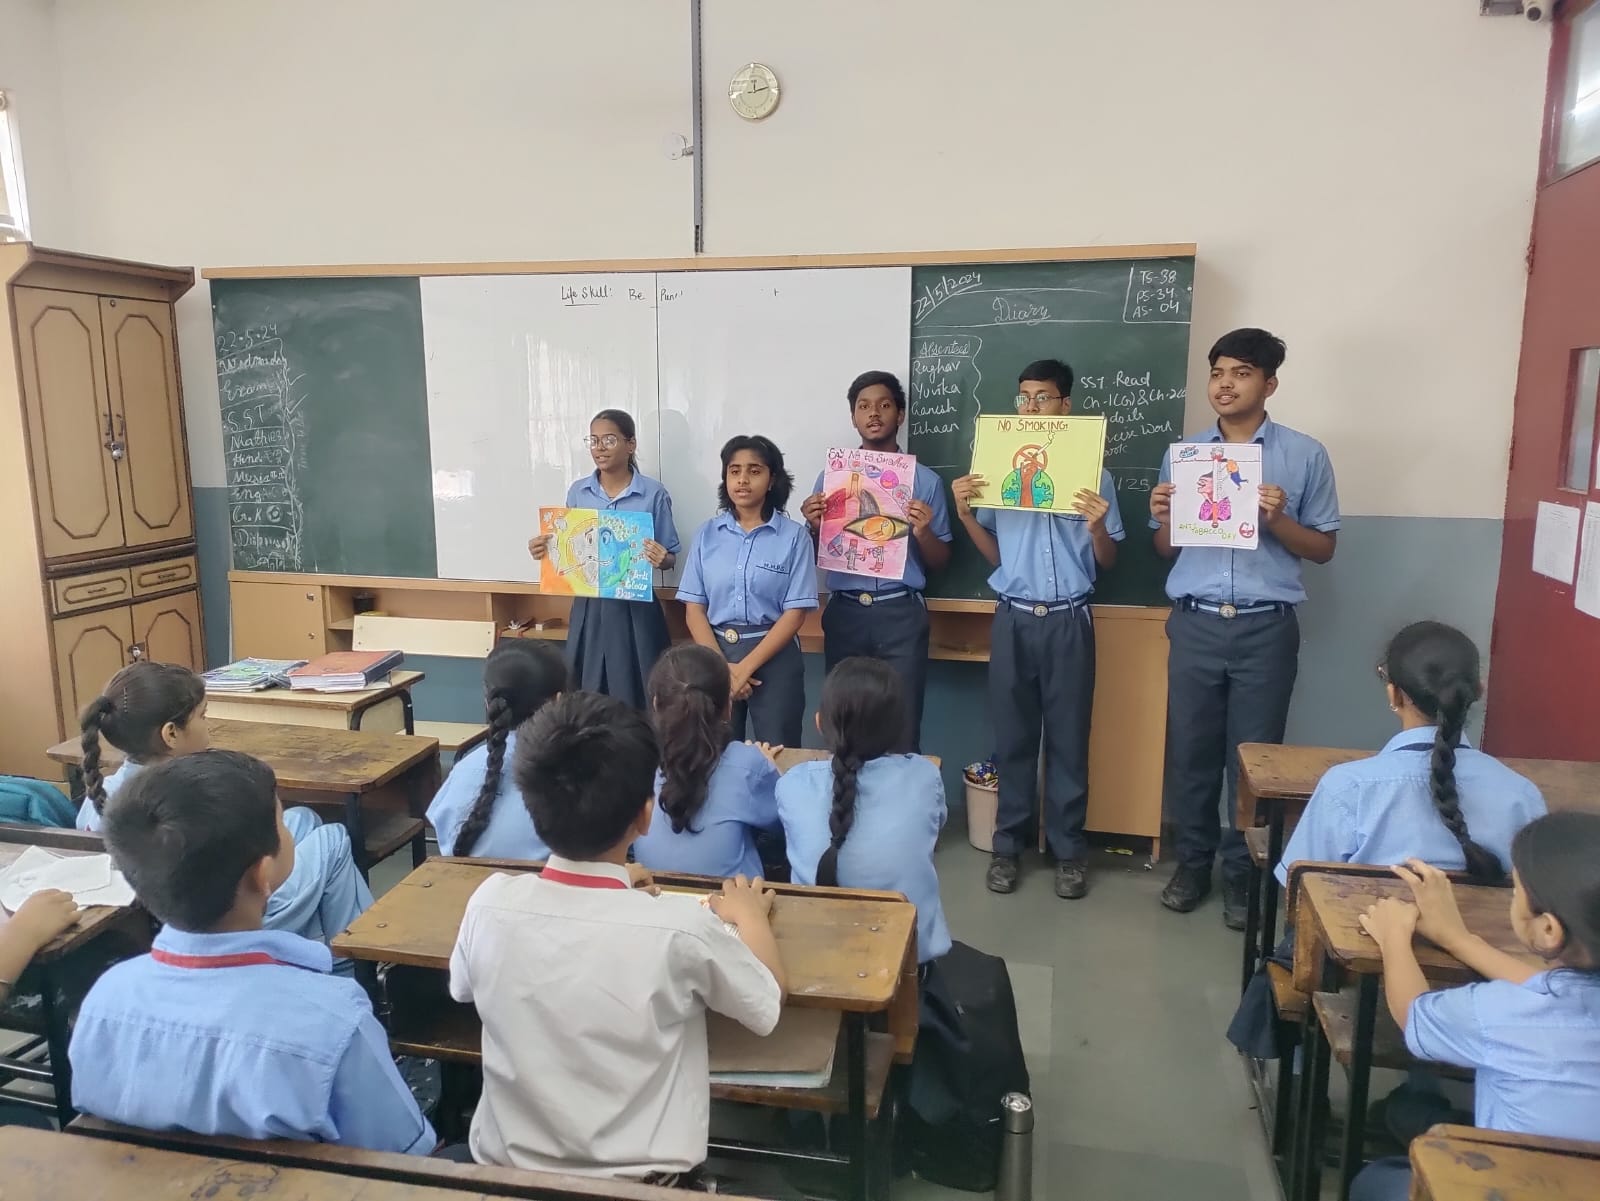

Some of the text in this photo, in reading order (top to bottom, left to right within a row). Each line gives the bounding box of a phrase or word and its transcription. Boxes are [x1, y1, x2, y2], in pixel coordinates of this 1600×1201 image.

[561, 285, 578, 304] Life
[628, 288, 645, 301] Be
[992, 296, 1050, 326] Diary
[912, 359, 960, 384] Raghav
[912, 378, 961, 399] Yuvika
[998, 419, 1011, 431] NO
